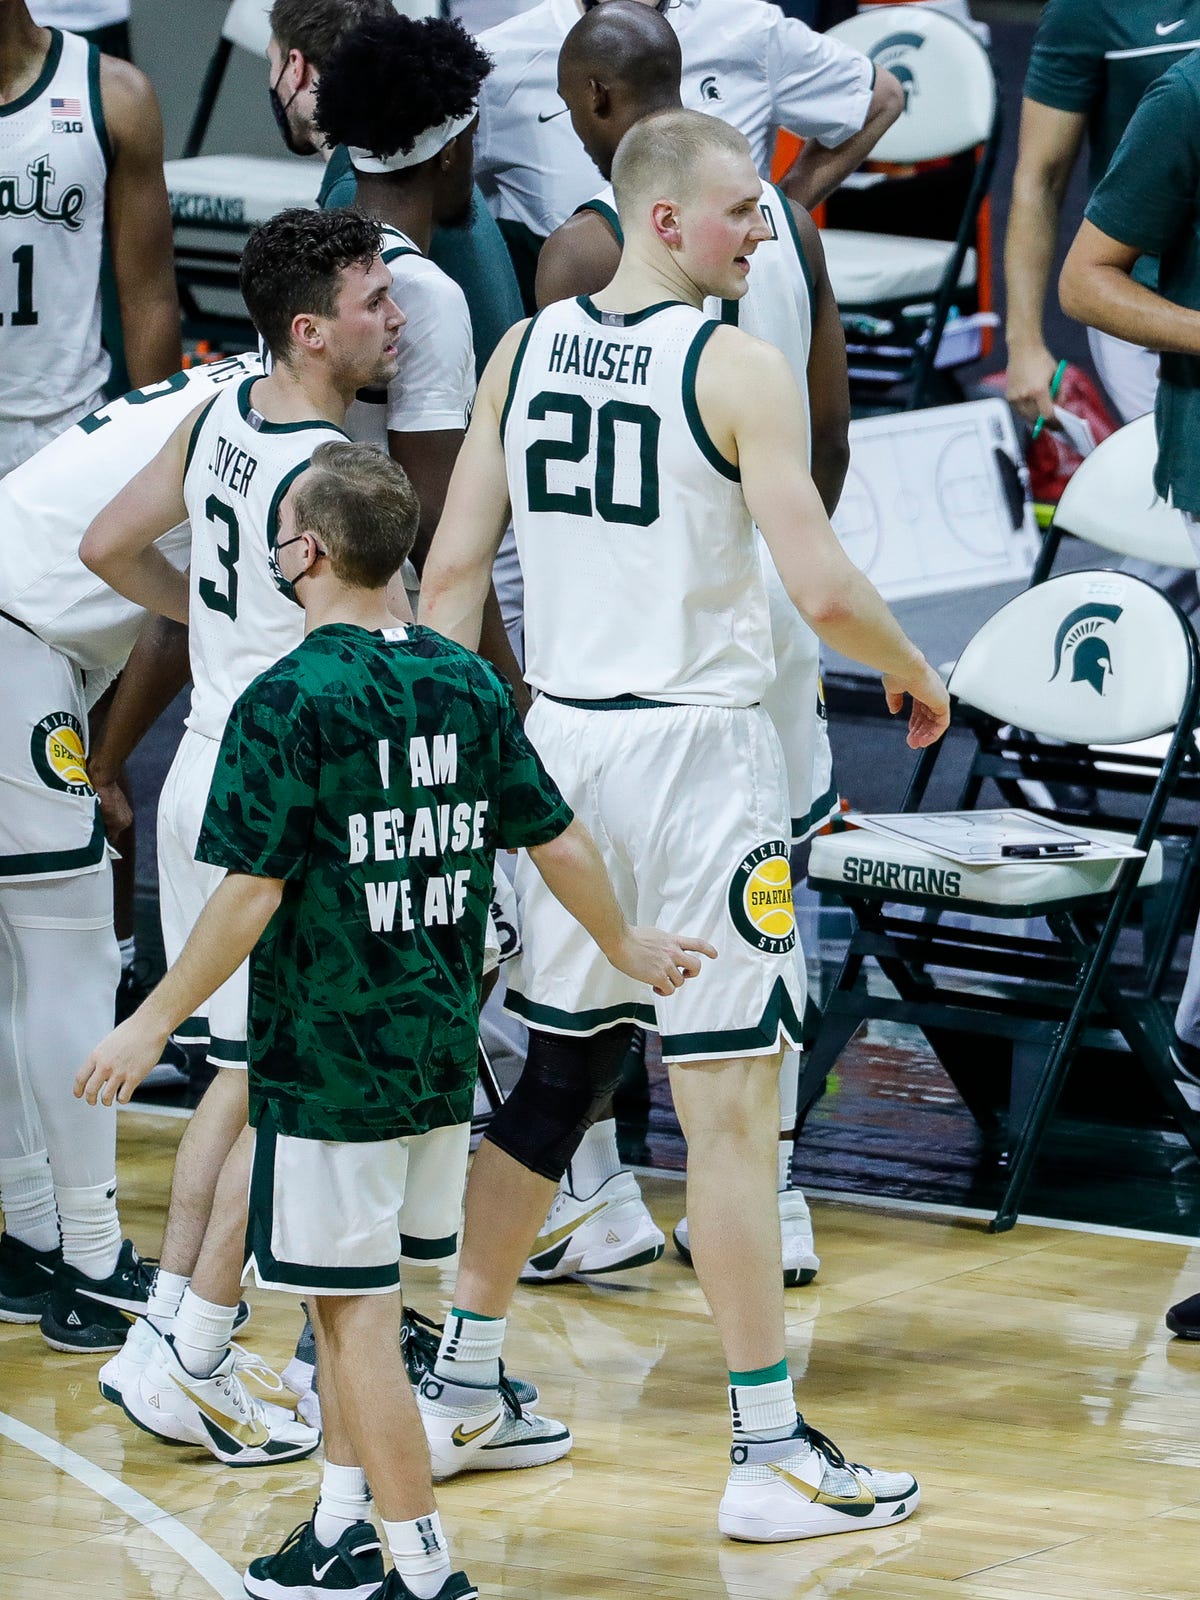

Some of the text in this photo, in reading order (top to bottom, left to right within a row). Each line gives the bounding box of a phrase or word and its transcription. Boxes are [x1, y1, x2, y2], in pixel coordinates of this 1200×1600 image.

[0, 153, 86, 232] ate
[0, 245, 38, 326] 1
[549, 333, 652, 386] HAUSER
[208, 435, 258, 498] OYER
[525, 390, 661, 528] 20
[199, 493, 240, 622] 3
[378, 733, 458, 789] I AM
[364, 879, 415, 932] WE
[424, 869, 471, 927] AE
[752, 888, 794, 906] SPARTAN
[842, 856, 962, 898] SPARTANS
